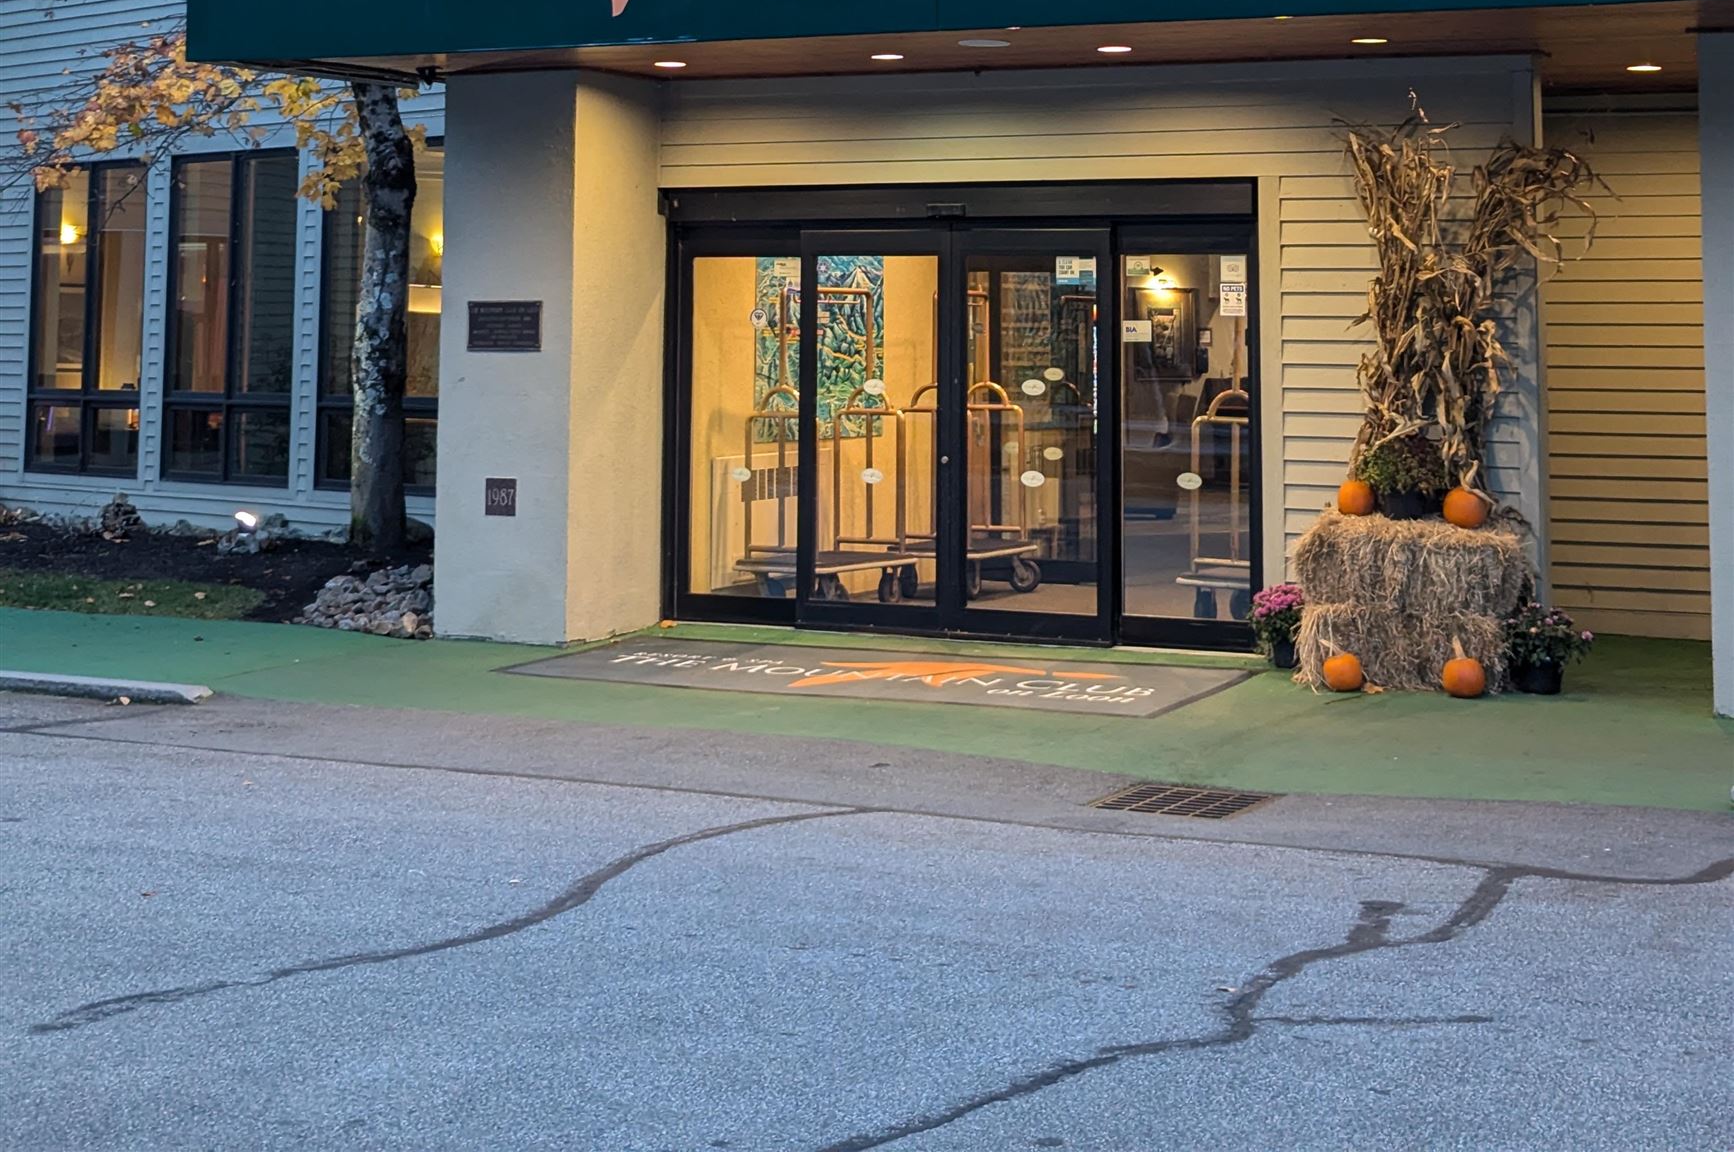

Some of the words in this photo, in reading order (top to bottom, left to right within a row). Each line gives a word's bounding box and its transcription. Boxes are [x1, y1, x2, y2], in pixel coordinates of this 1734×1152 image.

[487, 488, 515, 506] 1987
[609, 654, 707, 668] THE
[709, 661, 1003, 687] MOUNTAIN
[1016, 679, 1155, 697] CLUB
